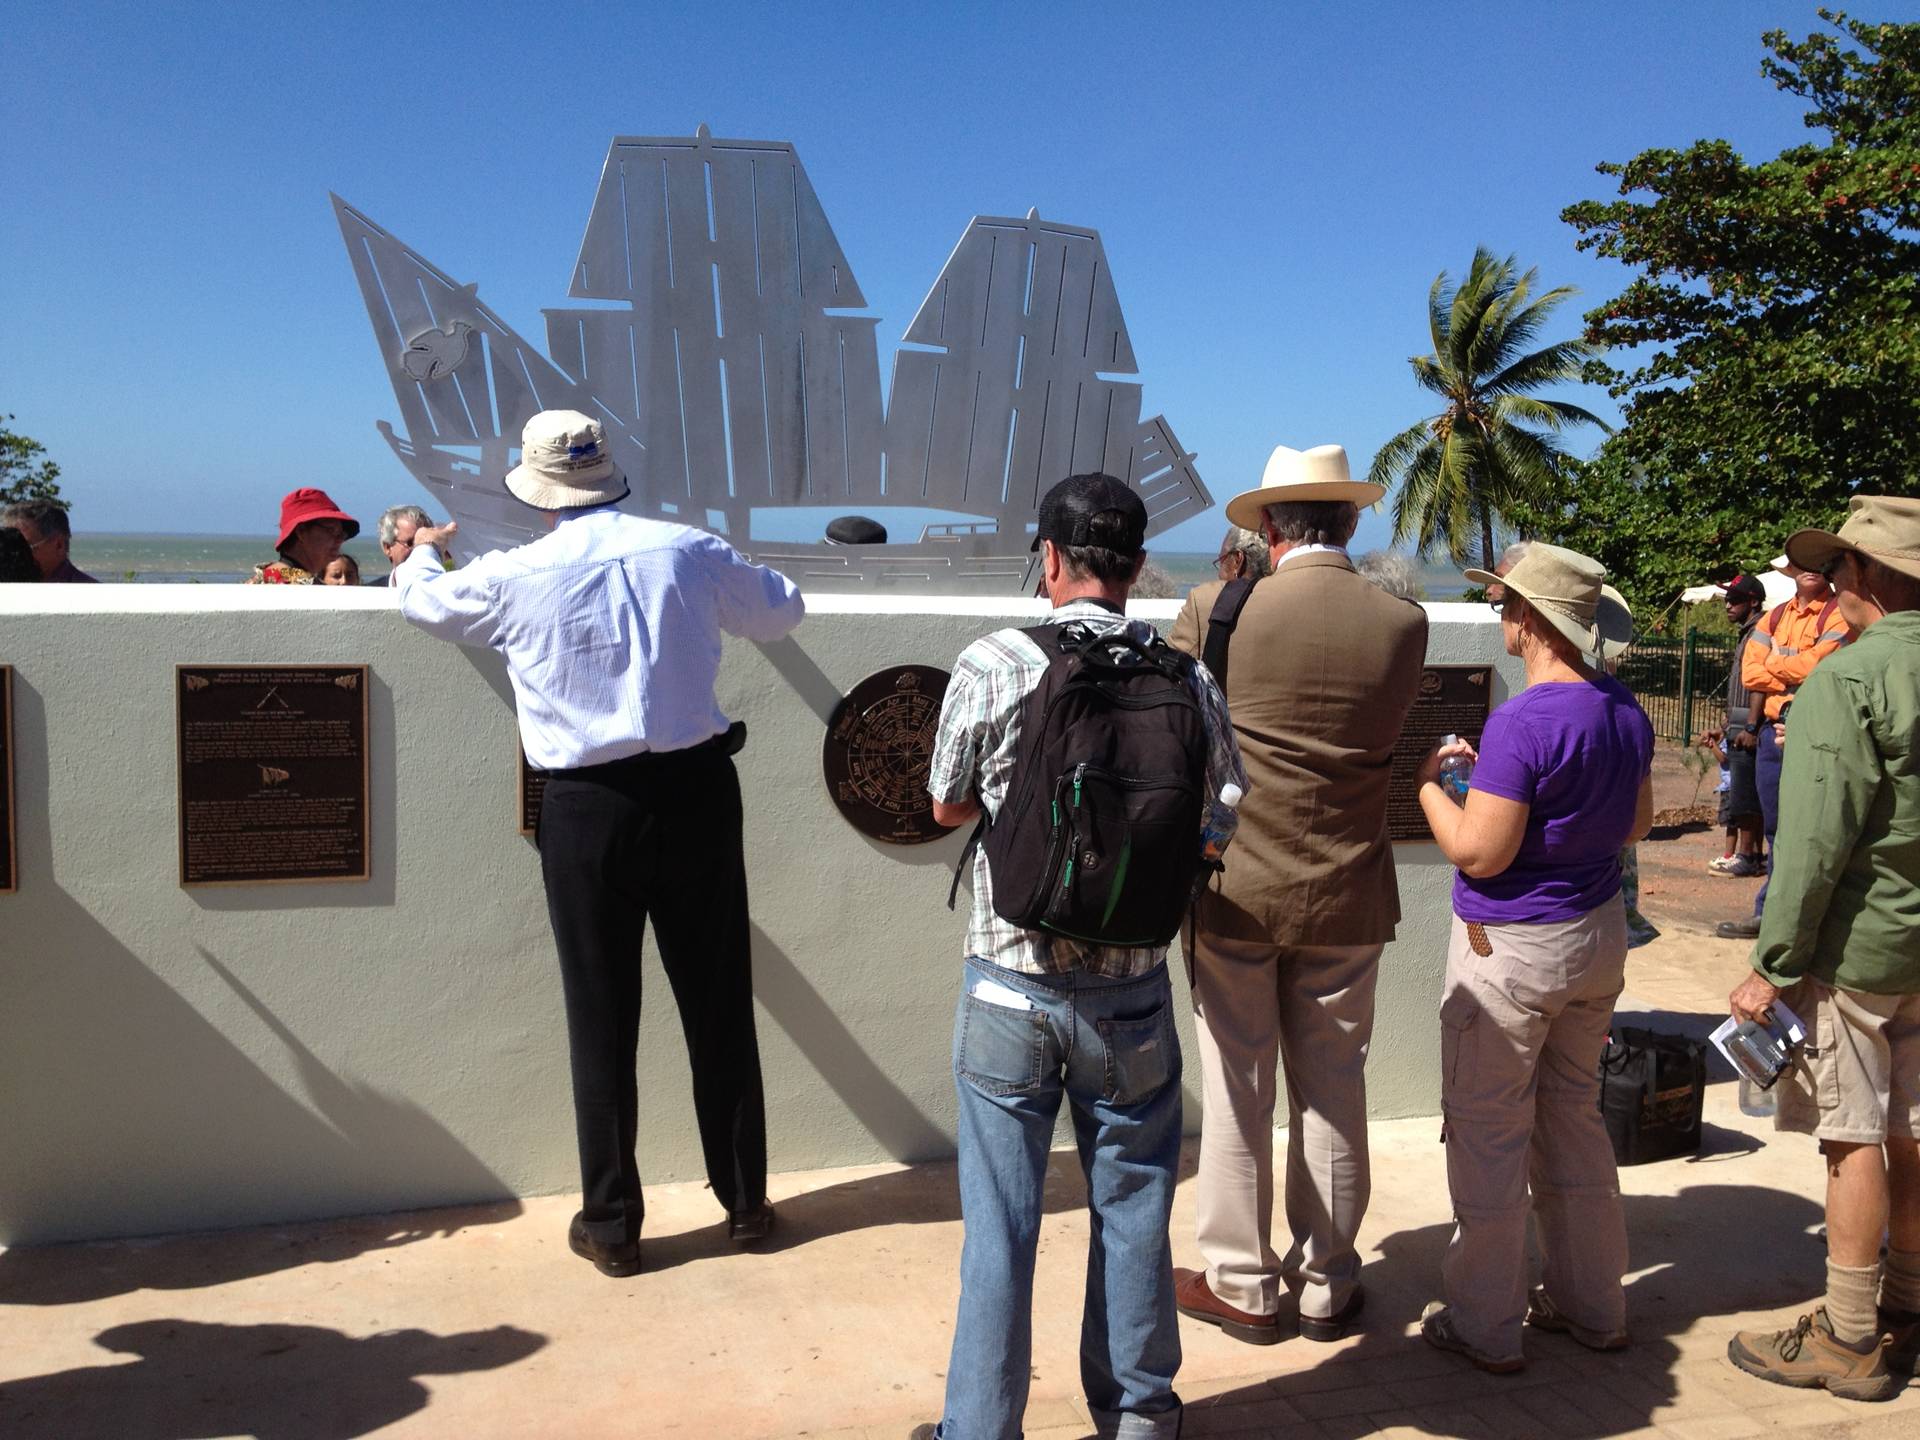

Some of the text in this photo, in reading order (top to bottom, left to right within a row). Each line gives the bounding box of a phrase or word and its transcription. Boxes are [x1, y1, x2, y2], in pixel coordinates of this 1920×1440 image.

[887, 699, 900, 707] Apr
[912, 697, 929, 708] May
[864, 711, 877, 723] Mar
[855, 733, 864, 749] Feb
[853, 762, 862, 777] Jan
[863, 784, 878, 799] Dec
[885, 800, 902, 812] Nov
[912, 801, 927, 810] Oct
